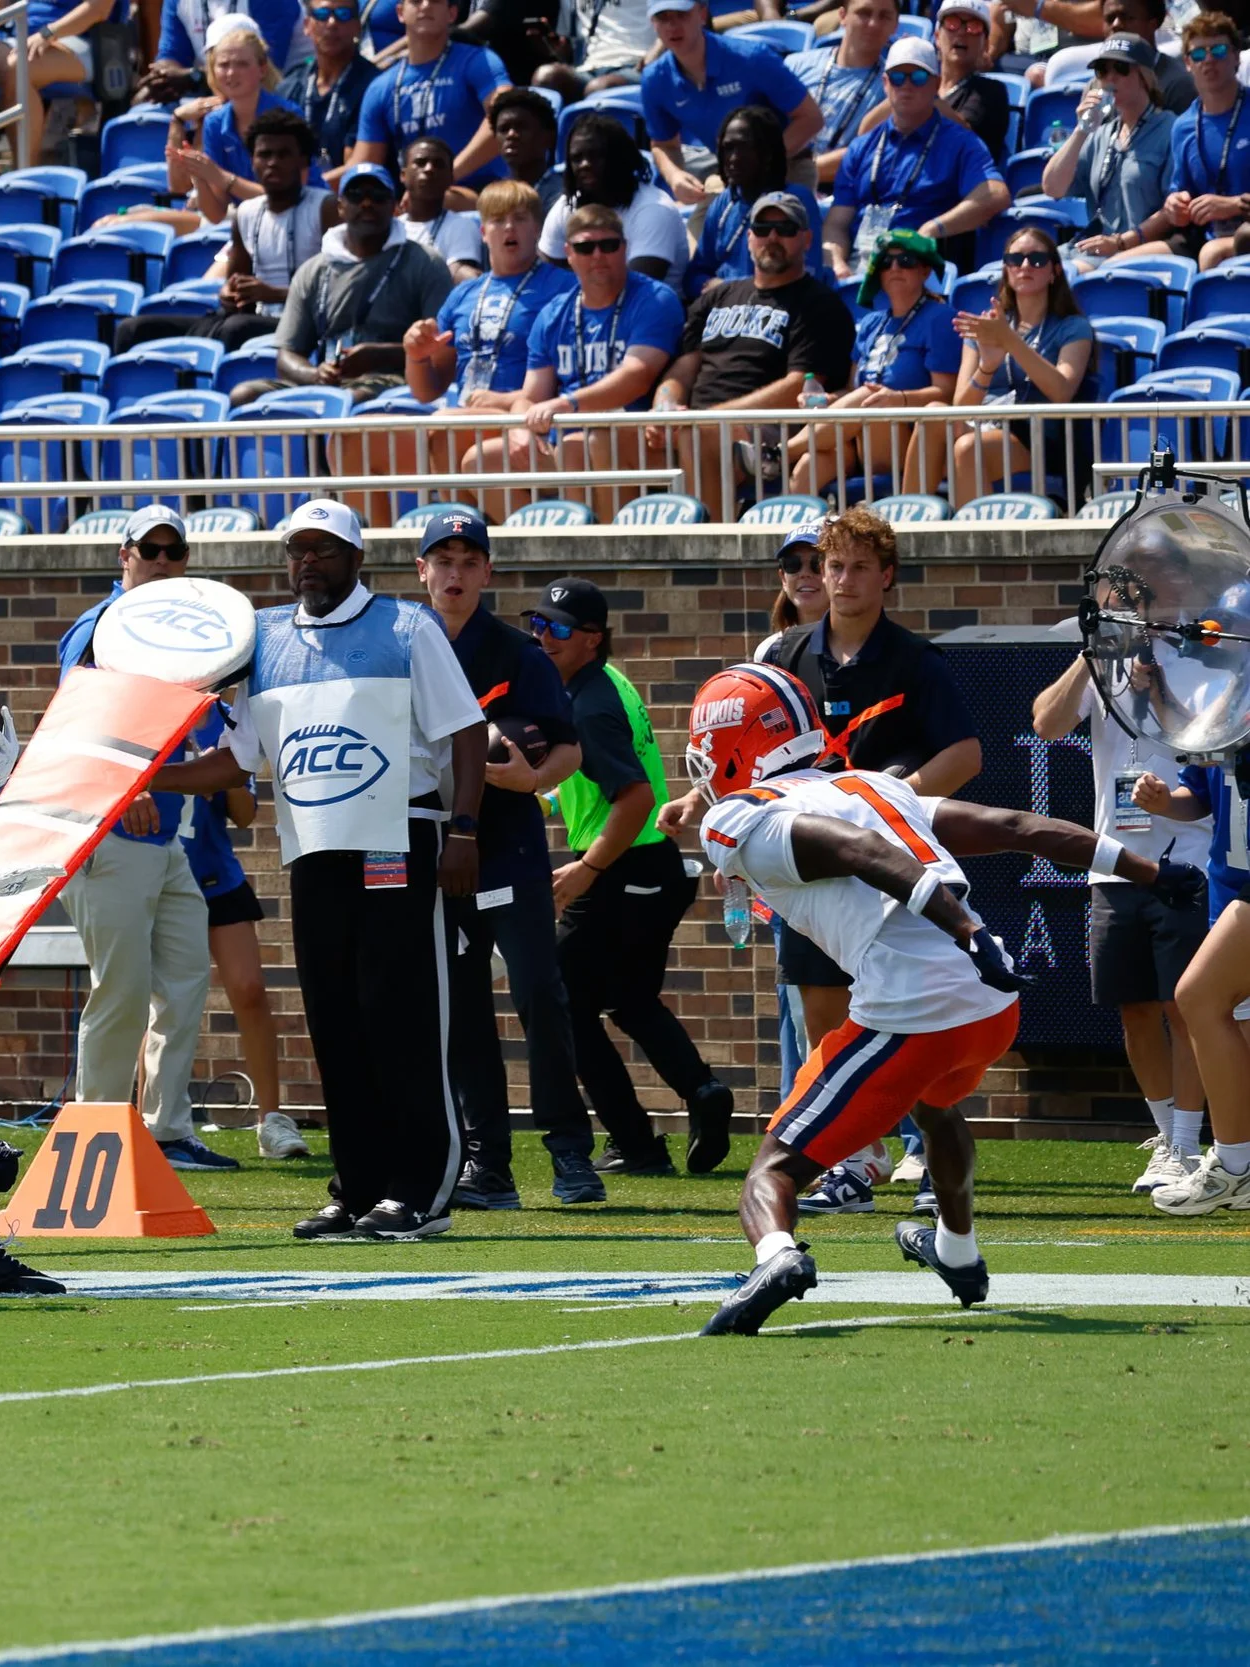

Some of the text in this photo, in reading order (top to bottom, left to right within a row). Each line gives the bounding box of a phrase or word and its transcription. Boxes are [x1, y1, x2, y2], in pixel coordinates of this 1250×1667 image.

[1102, 39, 1131, 51] UKE
[701, 303, 790, 349] DUKE
[790, 524, 821, 541] DUK
[134, 608, 225, 640] ACC
[693, 696, 746, 730] ILLINOIS
[282, 742, 370, 781] ACC
[830, 775, 941, 865] 1
[32, 1131, 123, 1229] 10
